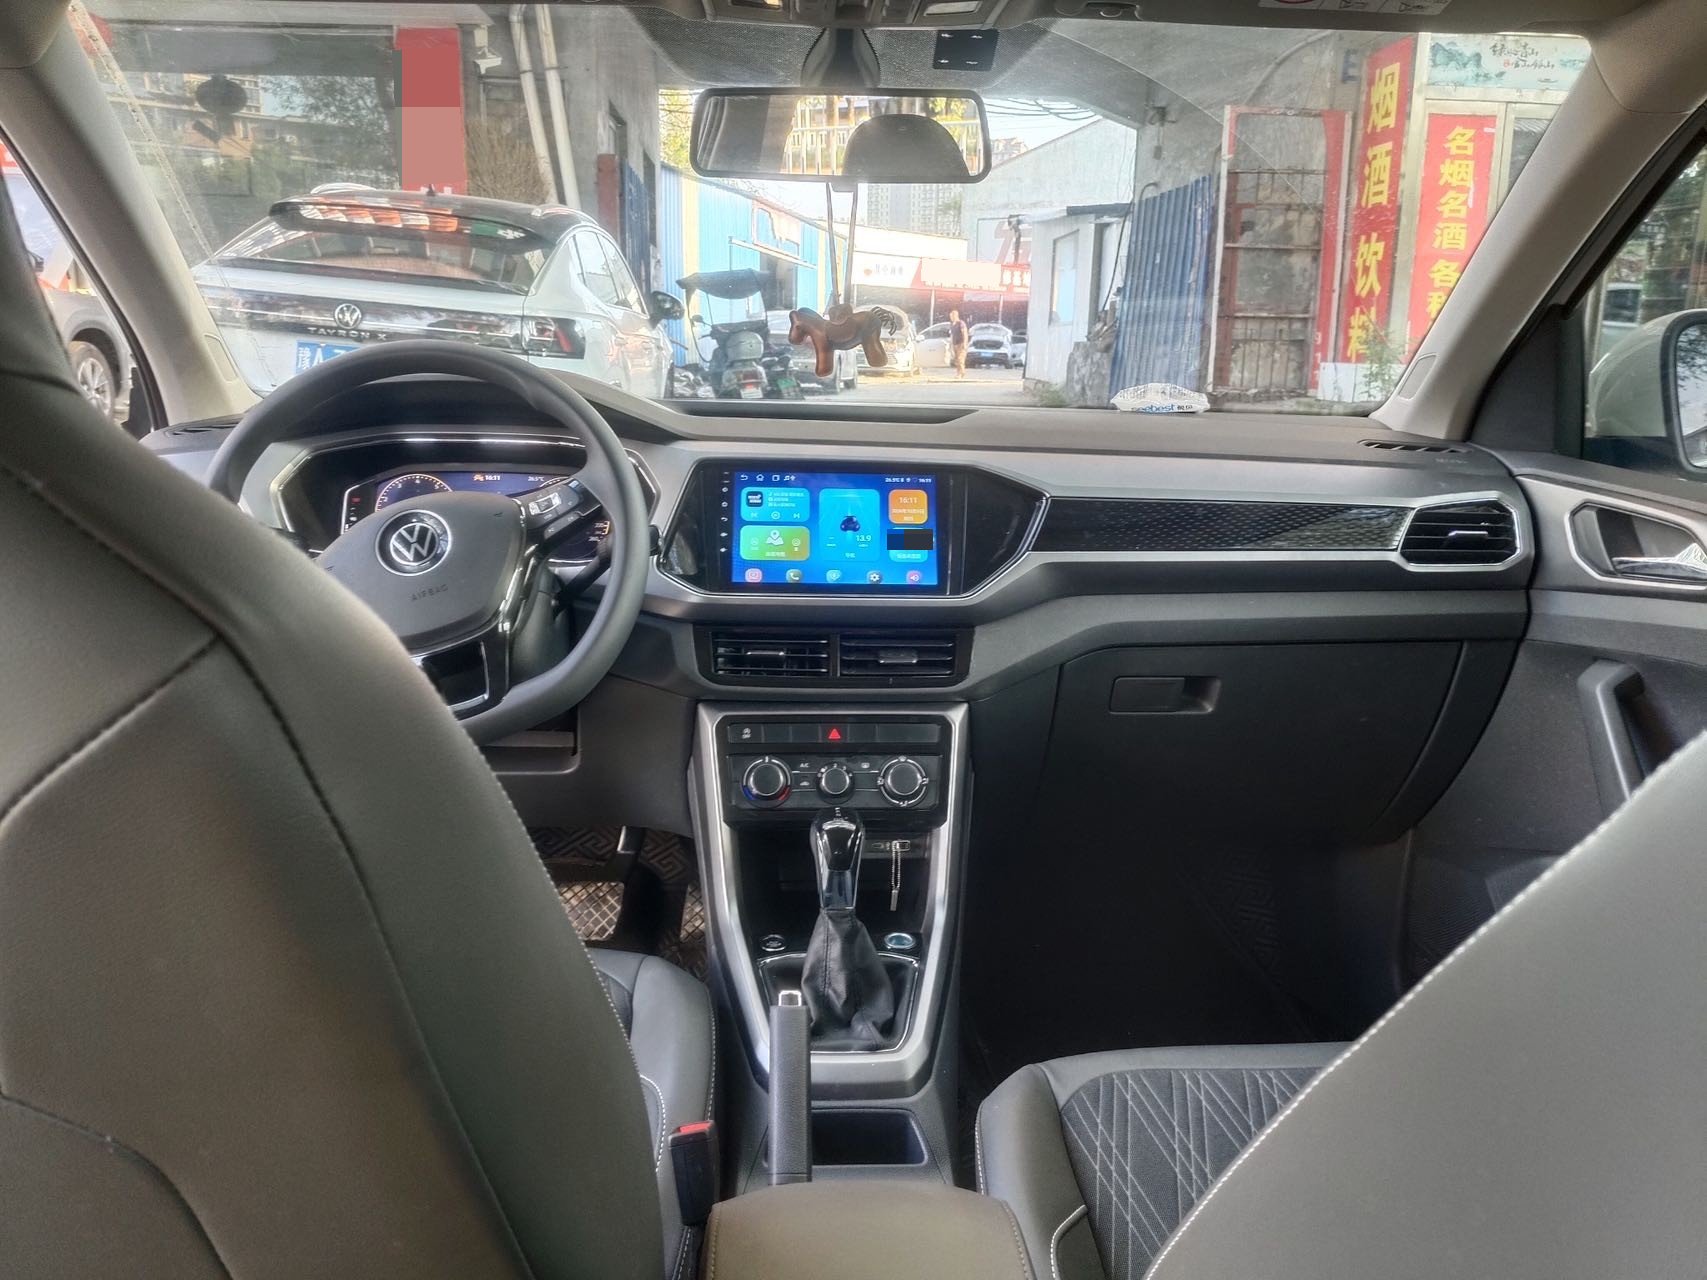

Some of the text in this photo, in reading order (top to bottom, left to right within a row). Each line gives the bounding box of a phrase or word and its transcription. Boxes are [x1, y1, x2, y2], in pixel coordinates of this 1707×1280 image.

[1347, 61, 1401, 363] 烟酒饮料
[307, 327, 387, 341] TAYRON X
[855, 534, 872, 542] 13.9
